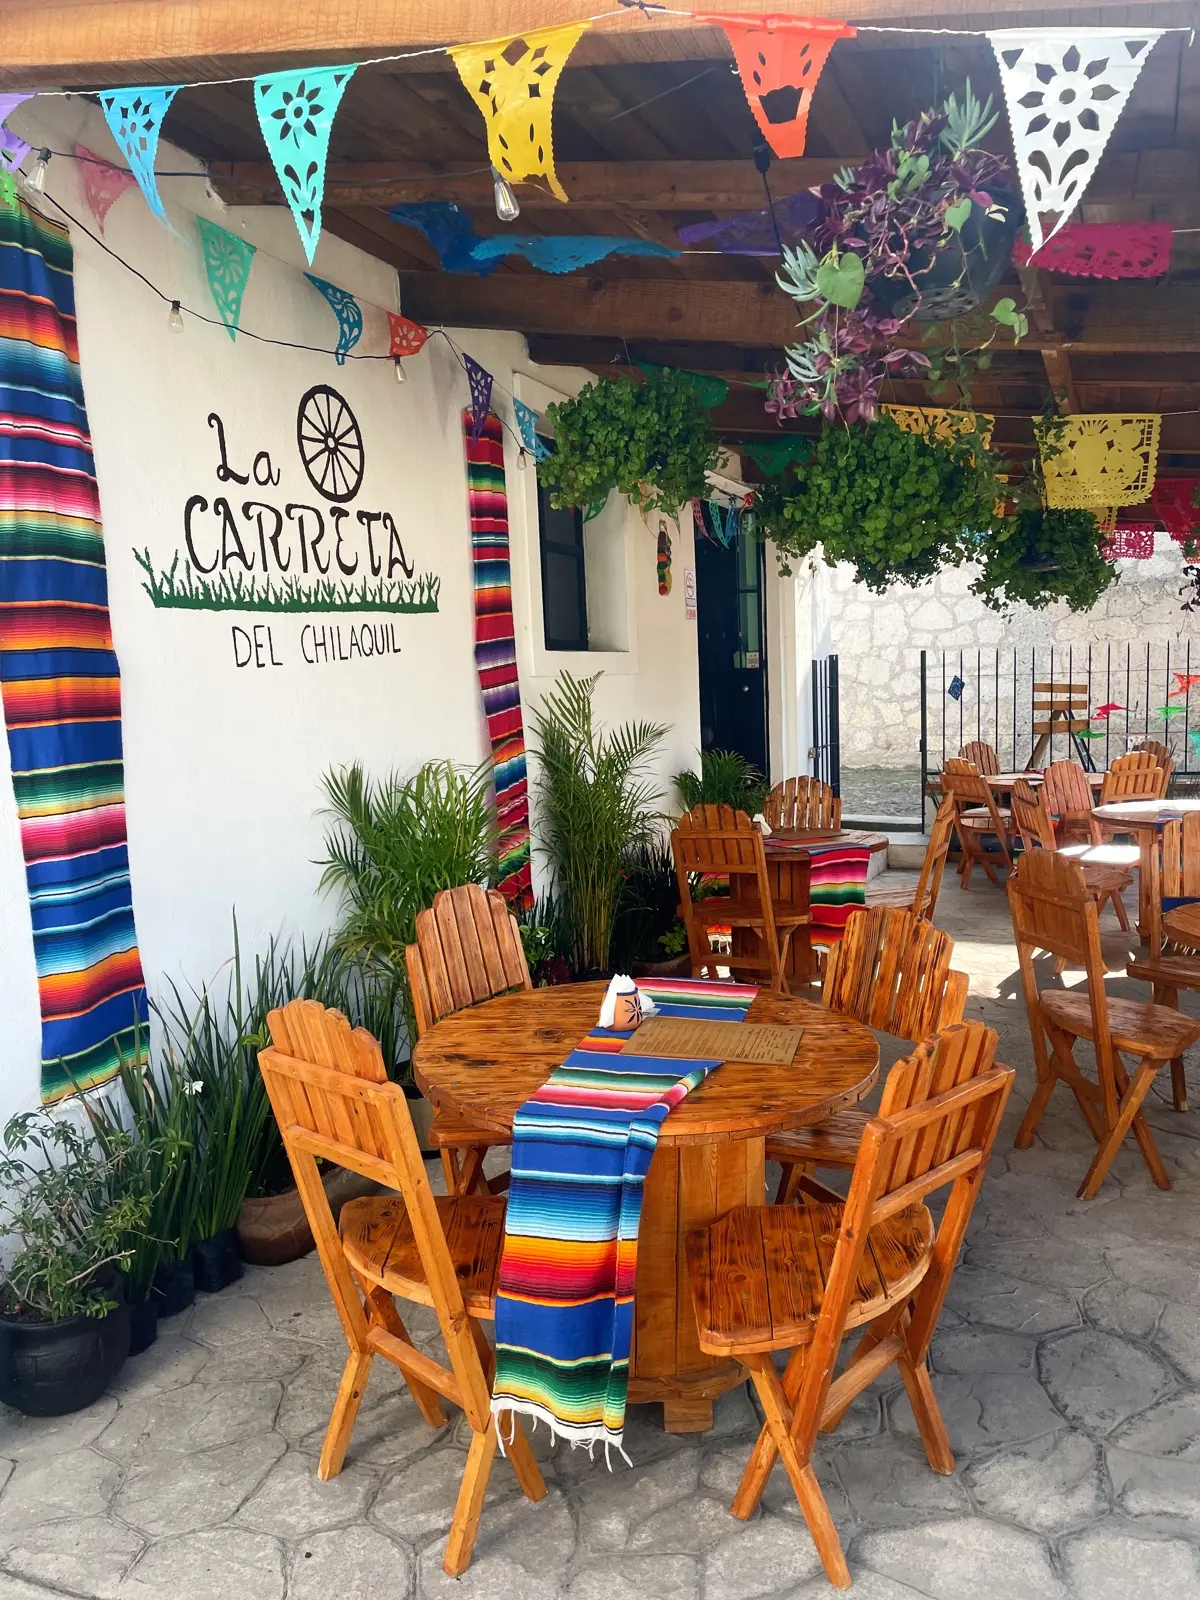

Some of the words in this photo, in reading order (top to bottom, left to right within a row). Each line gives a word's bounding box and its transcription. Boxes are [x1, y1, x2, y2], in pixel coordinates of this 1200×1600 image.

[207, 412, 280, 486] La
[184, 494, 414, 578] CARRETA
[231, 625, 283, 668] DEL
[300, 623, 401, 664] CHILAQUIL
